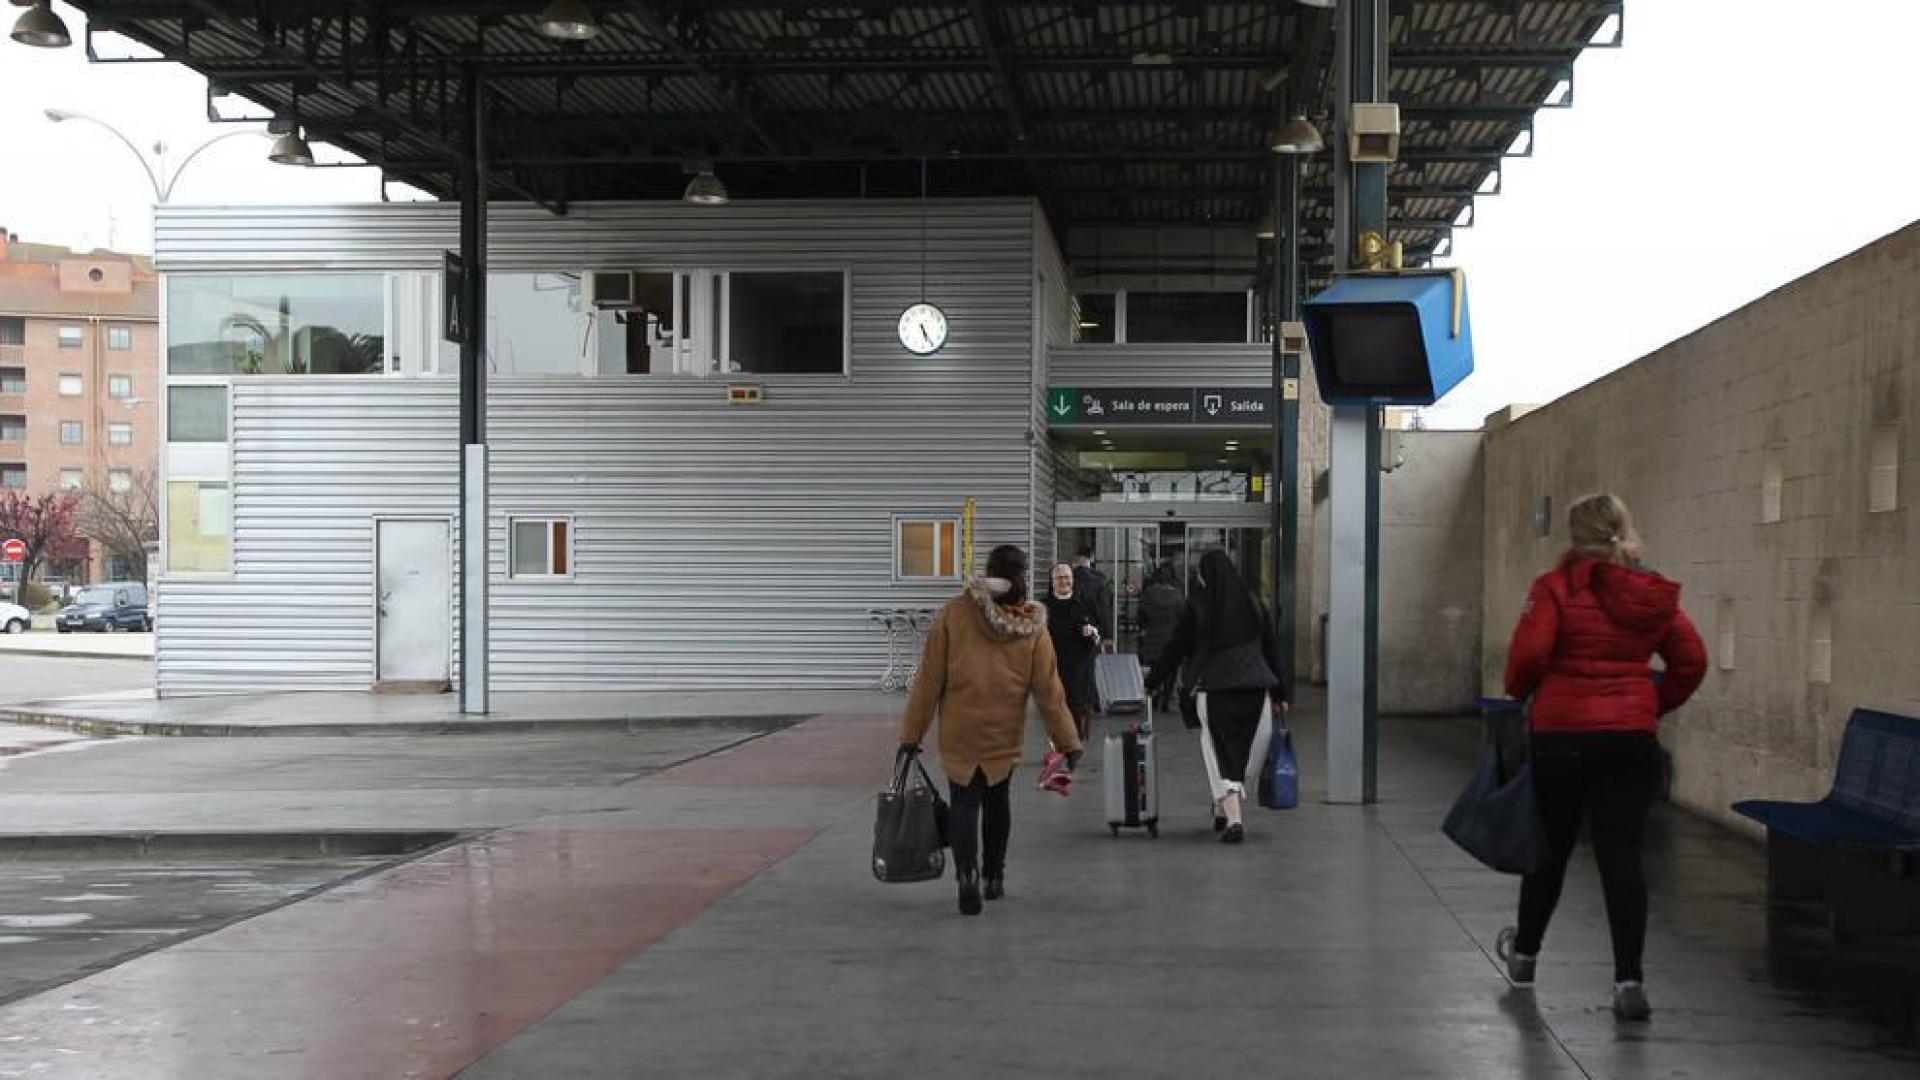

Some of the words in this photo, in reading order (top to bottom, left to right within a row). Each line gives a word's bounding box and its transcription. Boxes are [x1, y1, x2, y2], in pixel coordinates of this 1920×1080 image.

[1112, 400, 1134, 411] Sala
[1137, 400, 1151, 411] de
[1154, 401, 1190, 413] espera
[1230, 400, 1264, 412] Salida
